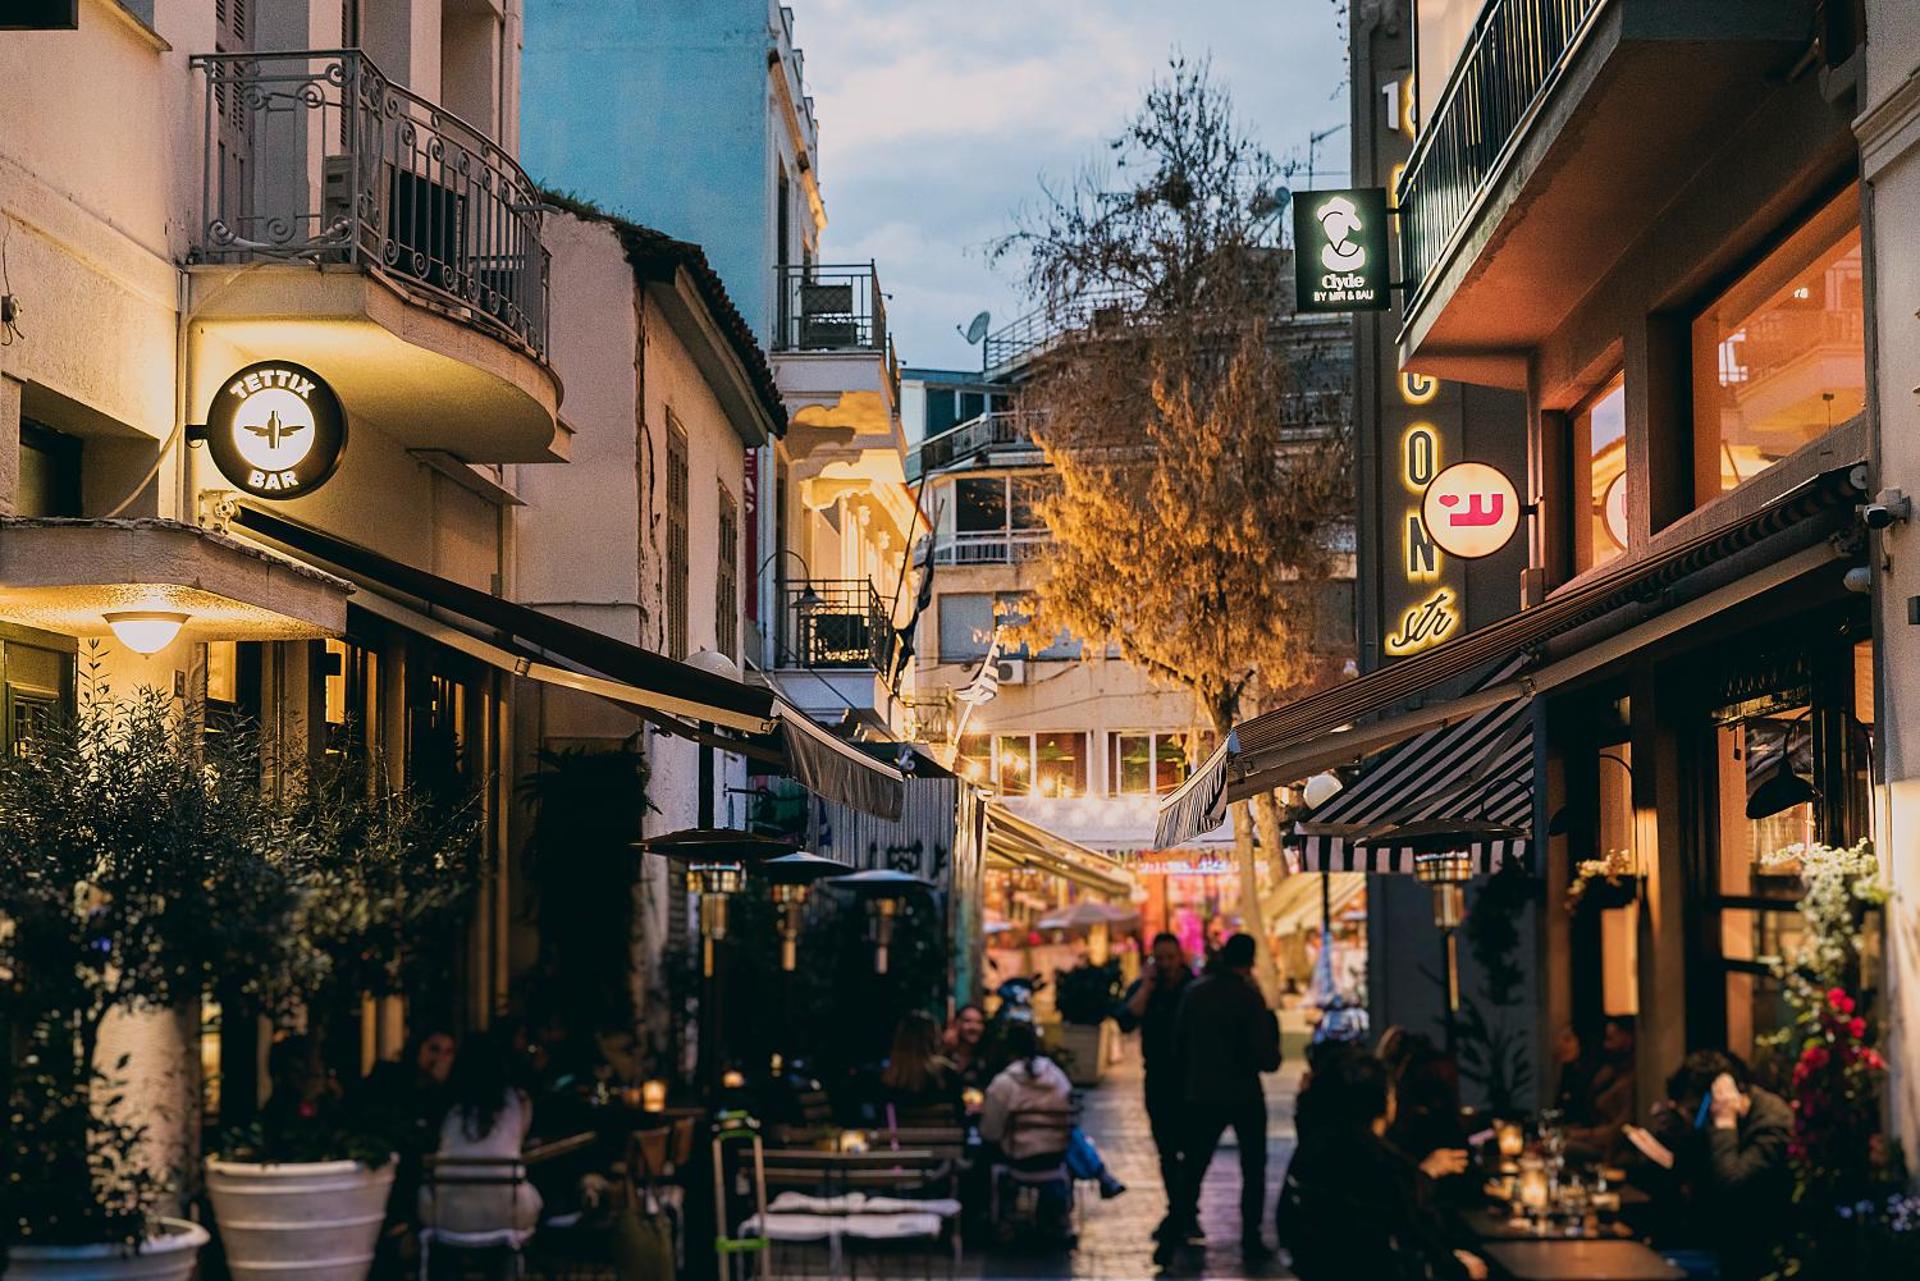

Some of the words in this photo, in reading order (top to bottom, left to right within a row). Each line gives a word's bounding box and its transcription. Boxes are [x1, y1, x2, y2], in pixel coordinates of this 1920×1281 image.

[1322, 273, 1365, 291] Clyde
[1314, 291, 1327, 302] BY
[229, 370, 316, 399] TETTIX
[248, 470, 299, 490] BAR
